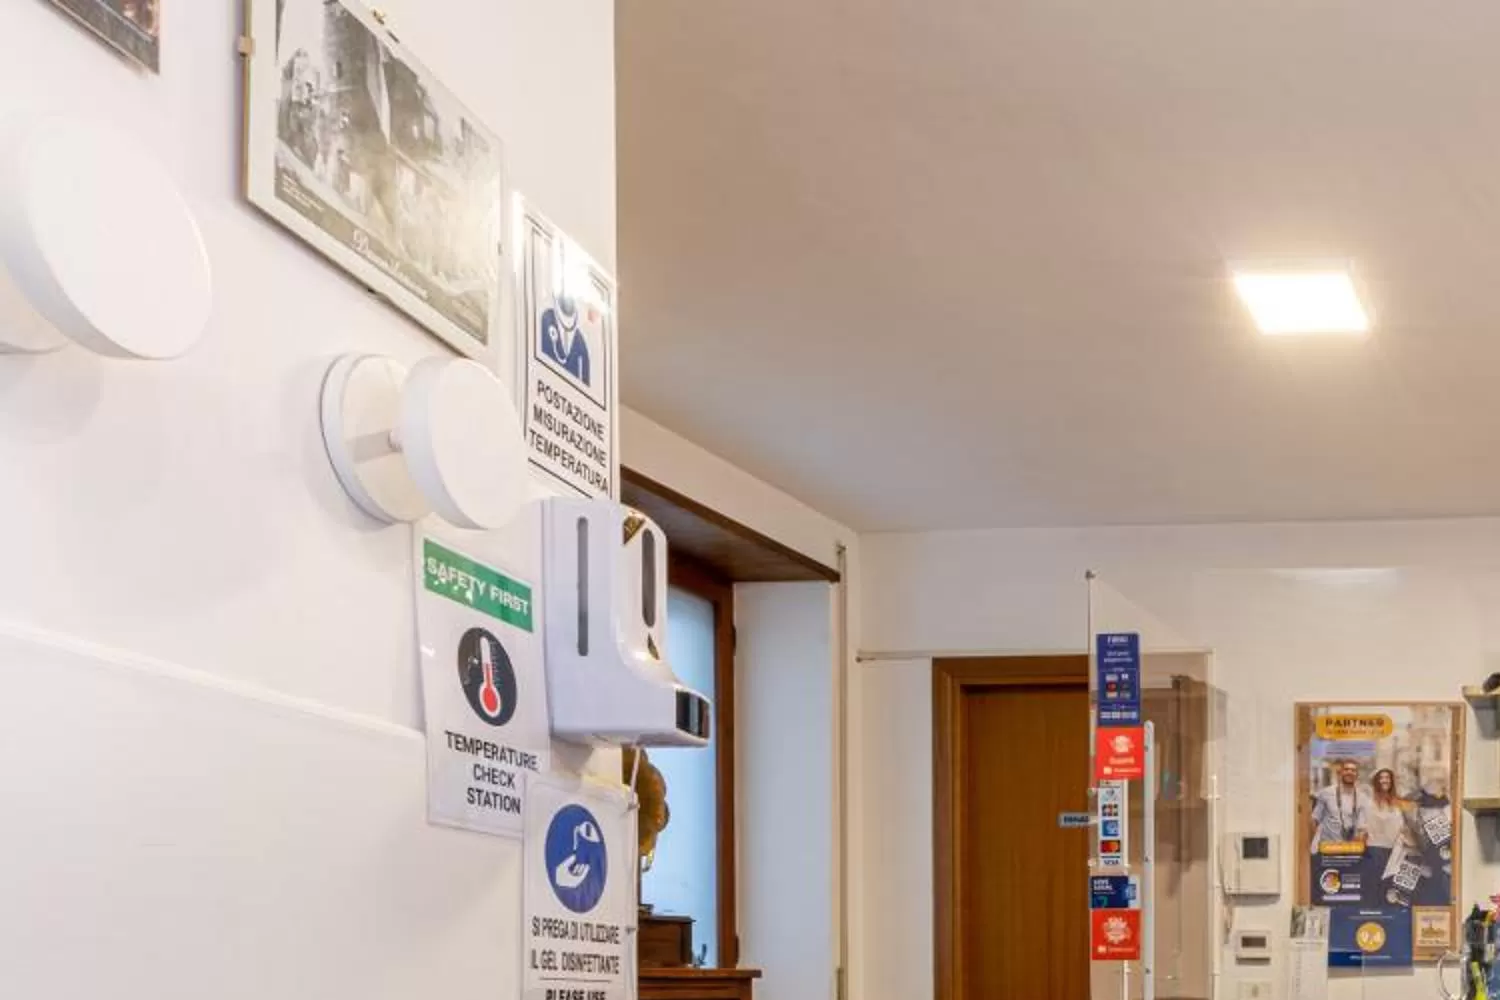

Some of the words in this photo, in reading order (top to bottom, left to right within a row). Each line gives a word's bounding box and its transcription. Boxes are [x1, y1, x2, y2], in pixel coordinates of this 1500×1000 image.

[537, 380, 605, 442] POSTAZIONE
[533, 404, 607, 468] MISURAZIONE
[529, 429, 609, 492] TEMPERATURA
[426, 556, 487, 597] SAFETY
[490, 583, 529, 615] FIRST
[444, 730, 538, 772] TEMPERATURE
[472, 763, 516, 789] CHECK
[466, 787, 521, 815] STATION
[542, 917, 568, 939] PREGA
[580, 921, 621, 945] UTILIZZARE
[541, 949, 558, 971] GEL
[562, 951, 620, 975] DISINFETTANTE
